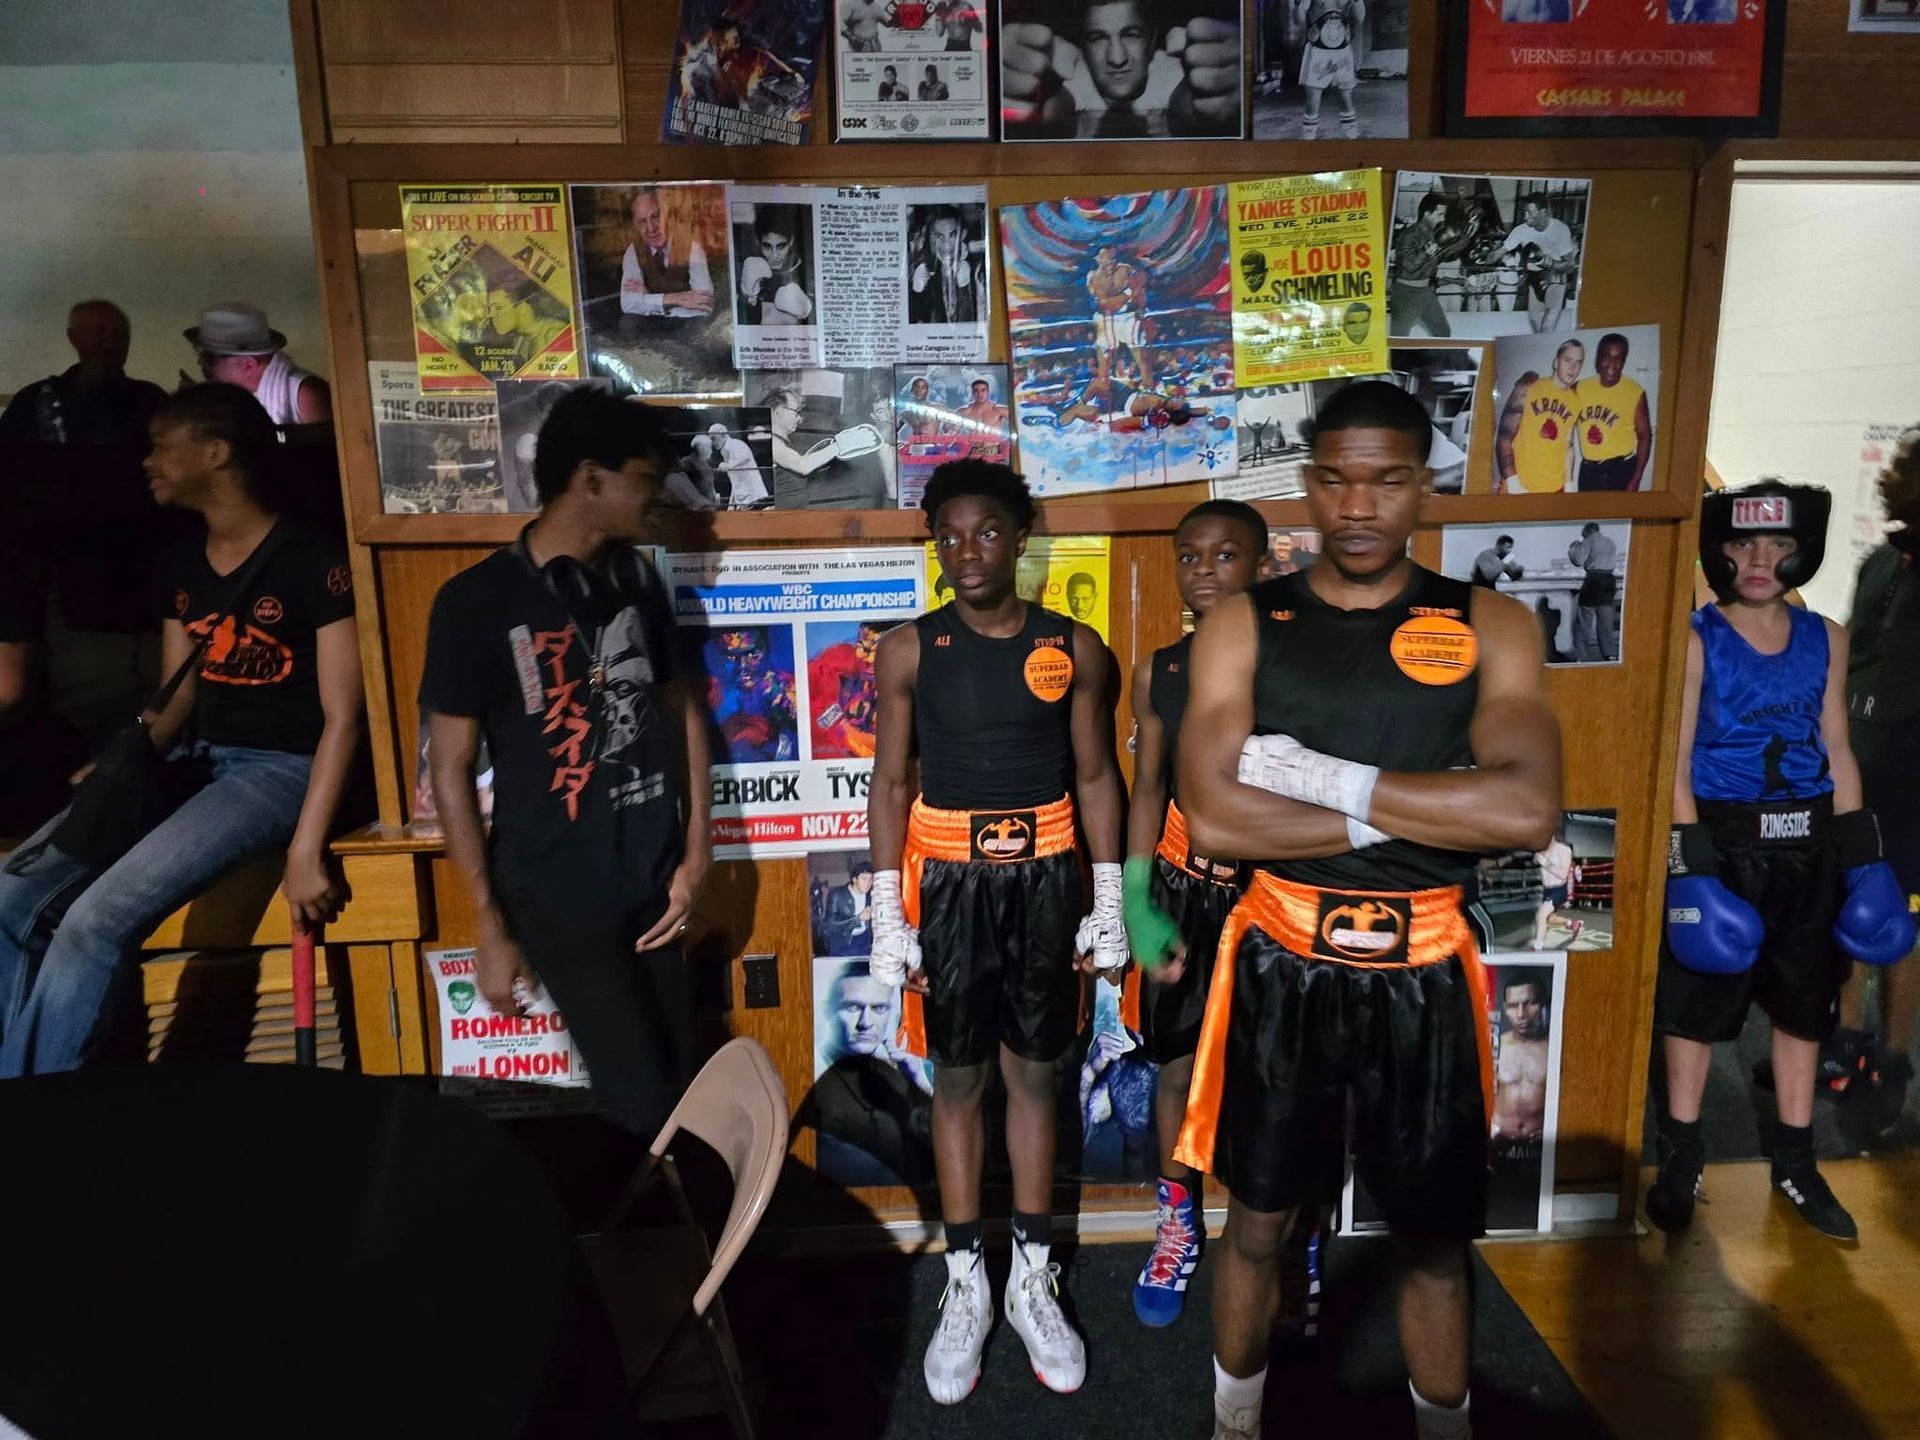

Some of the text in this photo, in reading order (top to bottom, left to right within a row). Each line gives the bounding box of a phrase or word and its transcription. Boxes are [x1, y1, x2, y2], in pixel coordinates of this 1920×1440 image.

[1511, 48, 1577, 65] VIERNES
[1579, 49, 1593, 65] 21
[1595, 49, 1616, 65] DE
[1619, 48, 1684, 66] AGOSTO
[1536, 89, 1688, 107] CAESARS PALACE
[429, 190, 447, 203] LIVE
[544, 191, 555, 201] TV
[1237, 190, 1368, 222] YANKEE STADIUM
[411, 205, 559, 233] SUPER FIGHT II
[1238, 223, 1268, 233] WED.
[1306, 214, 1340, 226] JUNE
[1347, 211, 1369, 222] 22
[511, 244, 557, 284] ALI
[1269, 258, 1289, 271] JOE
[1290, 242, 1371, 276] LOUIS
[1271, 270, 1374, 306] SCHMELING
[1242, 295, 1271, 305] MAX
[475, 346, 485, 356] 12
[426, 363, 459, 372] HOME TV
[537, 363, 569, 373] RADIO
[381, 380, 415, 391] Sports
[381, 399, 496, 424] THE GREATEST
[1530, 397, 1573, 424] KRONK
[1578, 405, 1621, 429] KRONK
[743, 563, 797, 572] ASSOCIATION
[886, 559, 915, 567] HILTON
[729, 594, 819, 612] HEAVYWEIGHT
[820, 589, 915, 608] CHAMPIONSHIP
[781, 584, 813, 595] WBC
[1032, 674, 1068, 683] ACADEMY
[712, 773, 801, 805] ERBICK
[753, 820, 796, 836] Hilton
[1759, 810, 1812, 839] RINGSIDE
[450, 1010, 568, 1041] ROMERO
[478, 1049, 570, 1080] LONON
